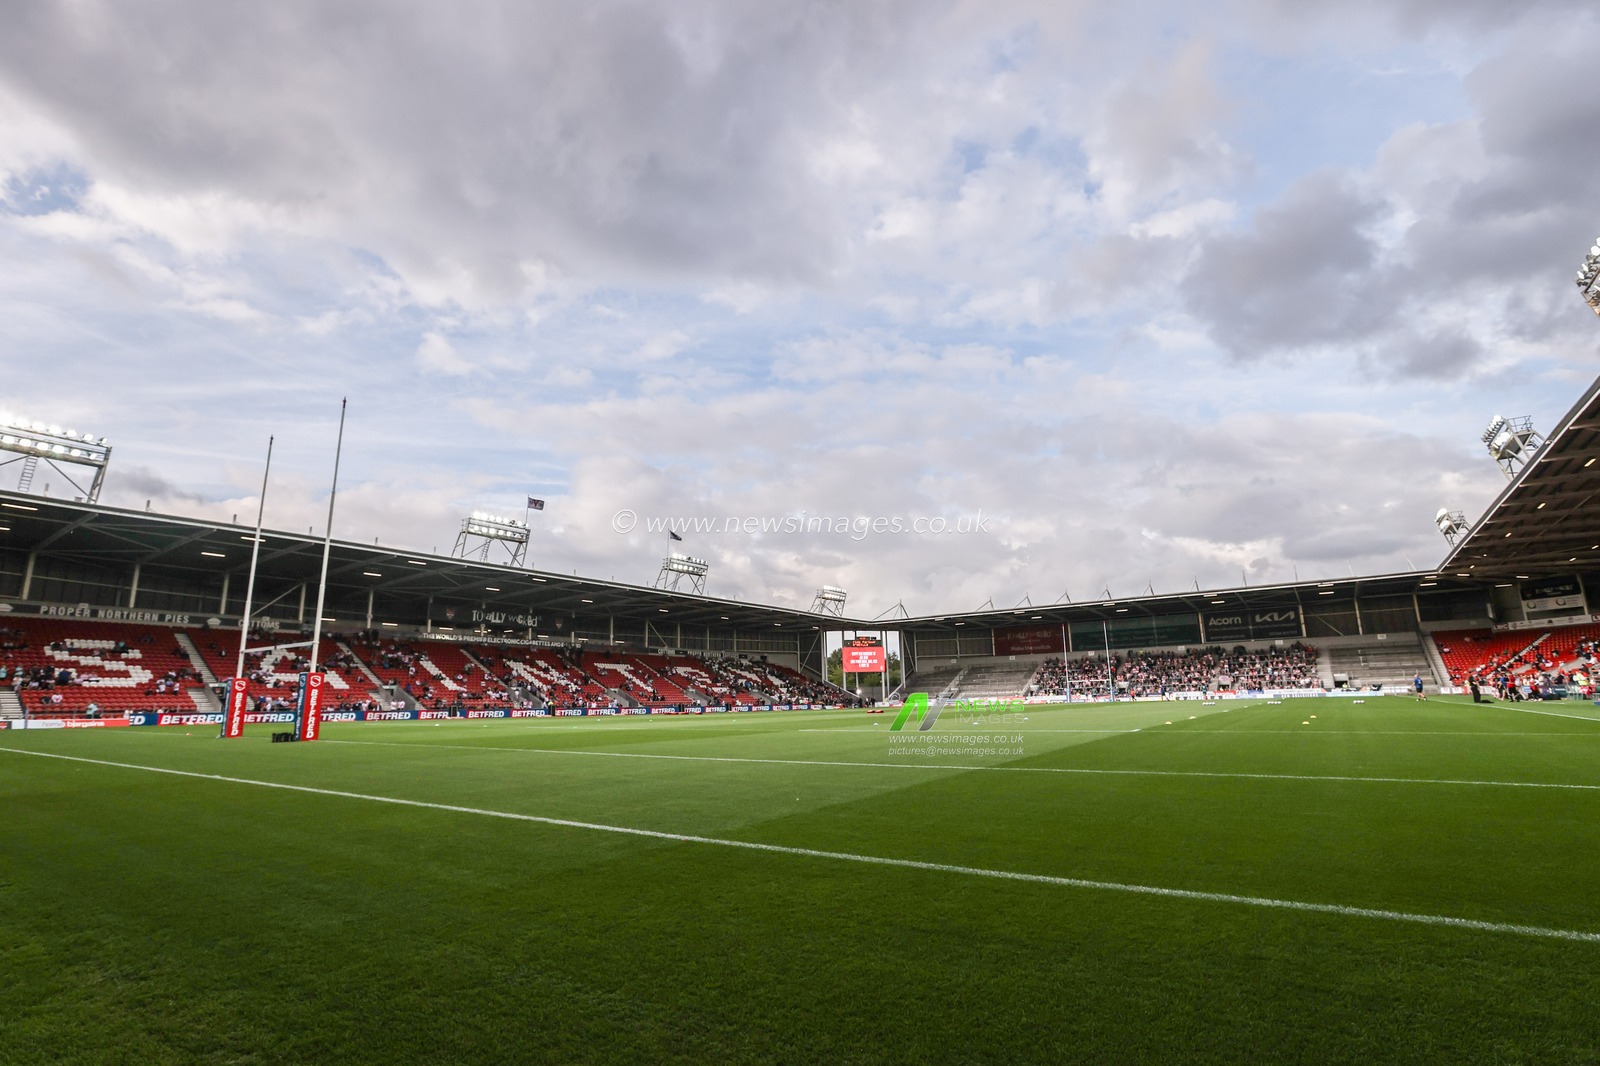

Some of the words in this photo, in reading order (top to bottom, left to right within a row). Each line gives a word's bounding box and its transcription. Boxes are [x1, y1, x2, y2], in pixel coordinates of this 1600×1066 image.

[40, 605, 91, 617] PROPER
[97, 609, 159, 622] NORTHERN
[165, 613, 189, 624] PIES
[1208, 616, 1242, 626] Acorn
[1255, 610, 1295, 623] KIA
[238, 619, 280, 629] CTTONS
[436, 633, 462, 641] WORLD'S
[488, 637, 520, 645] ELECTRONIC
[520, 639, 550, 647] CIGARETTES
[231, 692, 243, 736] BETFRED
[306, 689, 318, 738] BETFRED
[320, 713, 356, 721] TFRED
[365, 711, 411, 720] BETFRED
[467, 710, 503, 718] BETFRED
[510, 709, 544, 717] BETFRED
[160, 714, 223, 725] BETFRED
